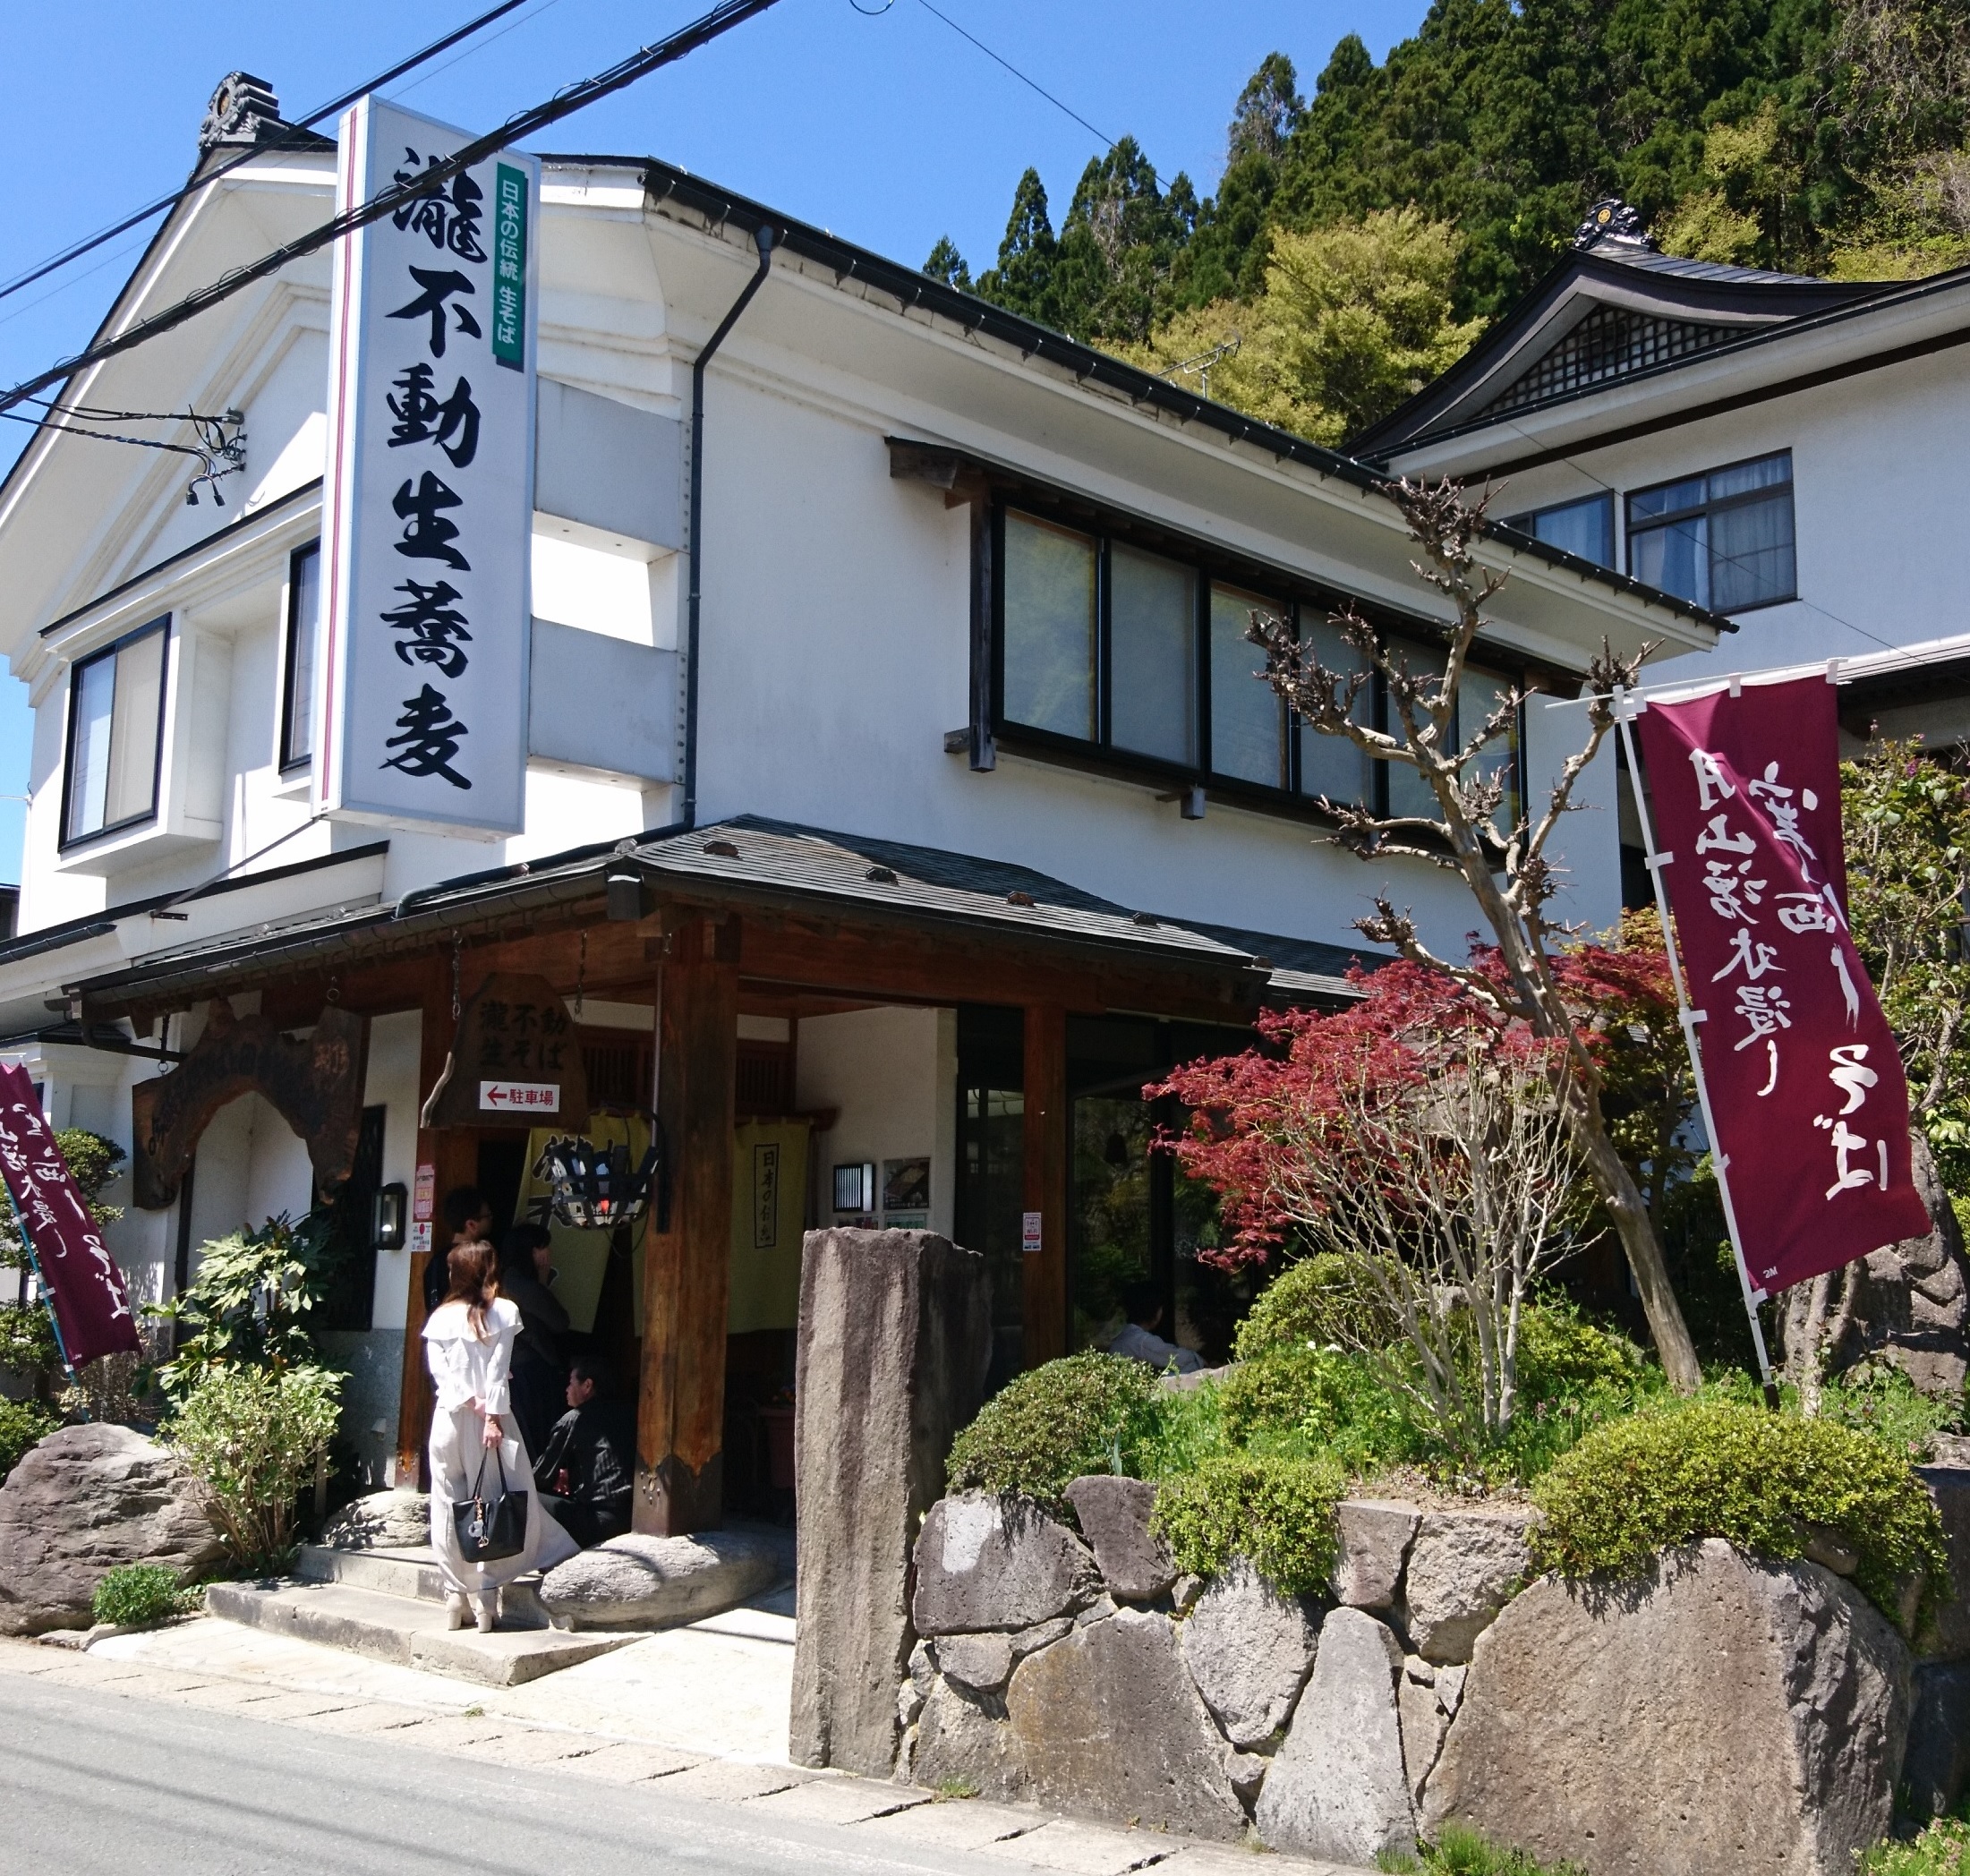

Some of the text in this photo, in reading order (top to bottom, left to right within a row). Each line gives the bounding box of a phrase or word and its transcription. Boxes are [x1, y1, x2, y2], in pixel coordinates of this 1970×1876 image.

[497, 180, 519, 345] 日本の伝統 生そば
[379, 147, 488, 790] 瀧不動生蕎麦
[508, 1087, 554, 1107] 駐車場
